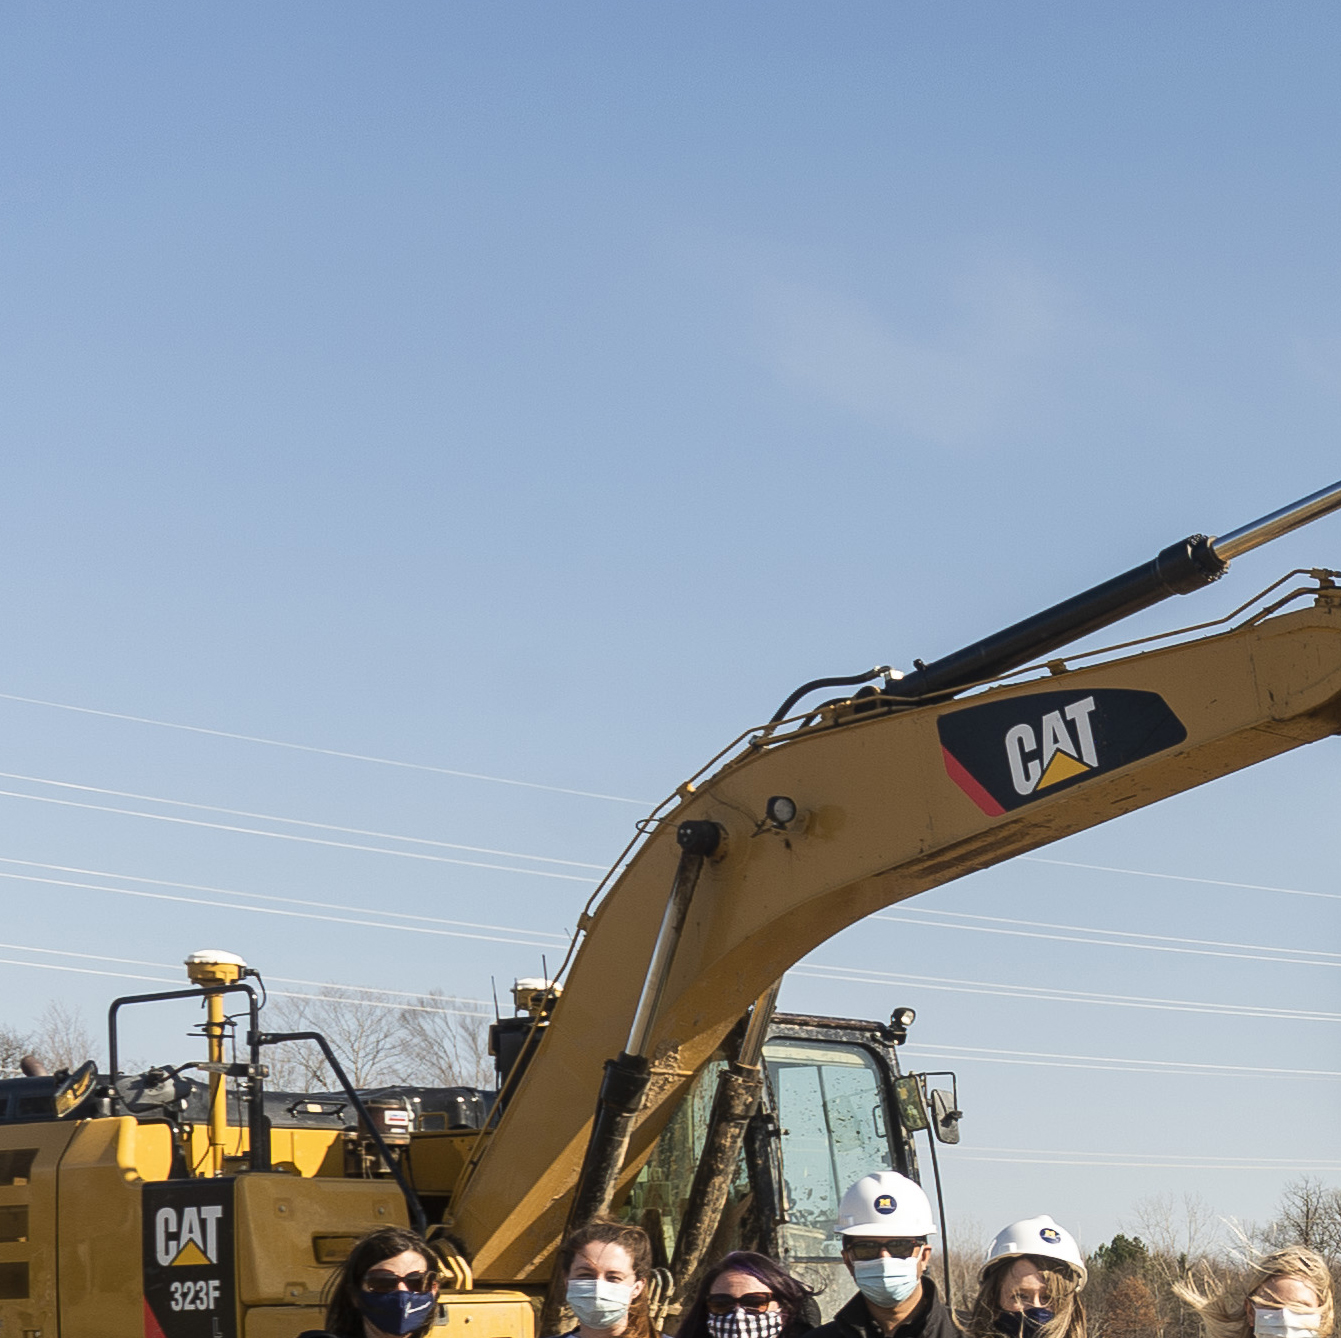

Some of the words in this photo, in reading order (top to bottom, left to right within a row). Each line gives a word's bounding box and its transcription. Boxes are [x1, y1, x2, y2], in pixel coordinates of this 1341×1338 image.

[1005, 696, 1099, 795] CAT
[156, 1205, 223, 1266] CAT
[170, 1280, 220, 1311] 323F
